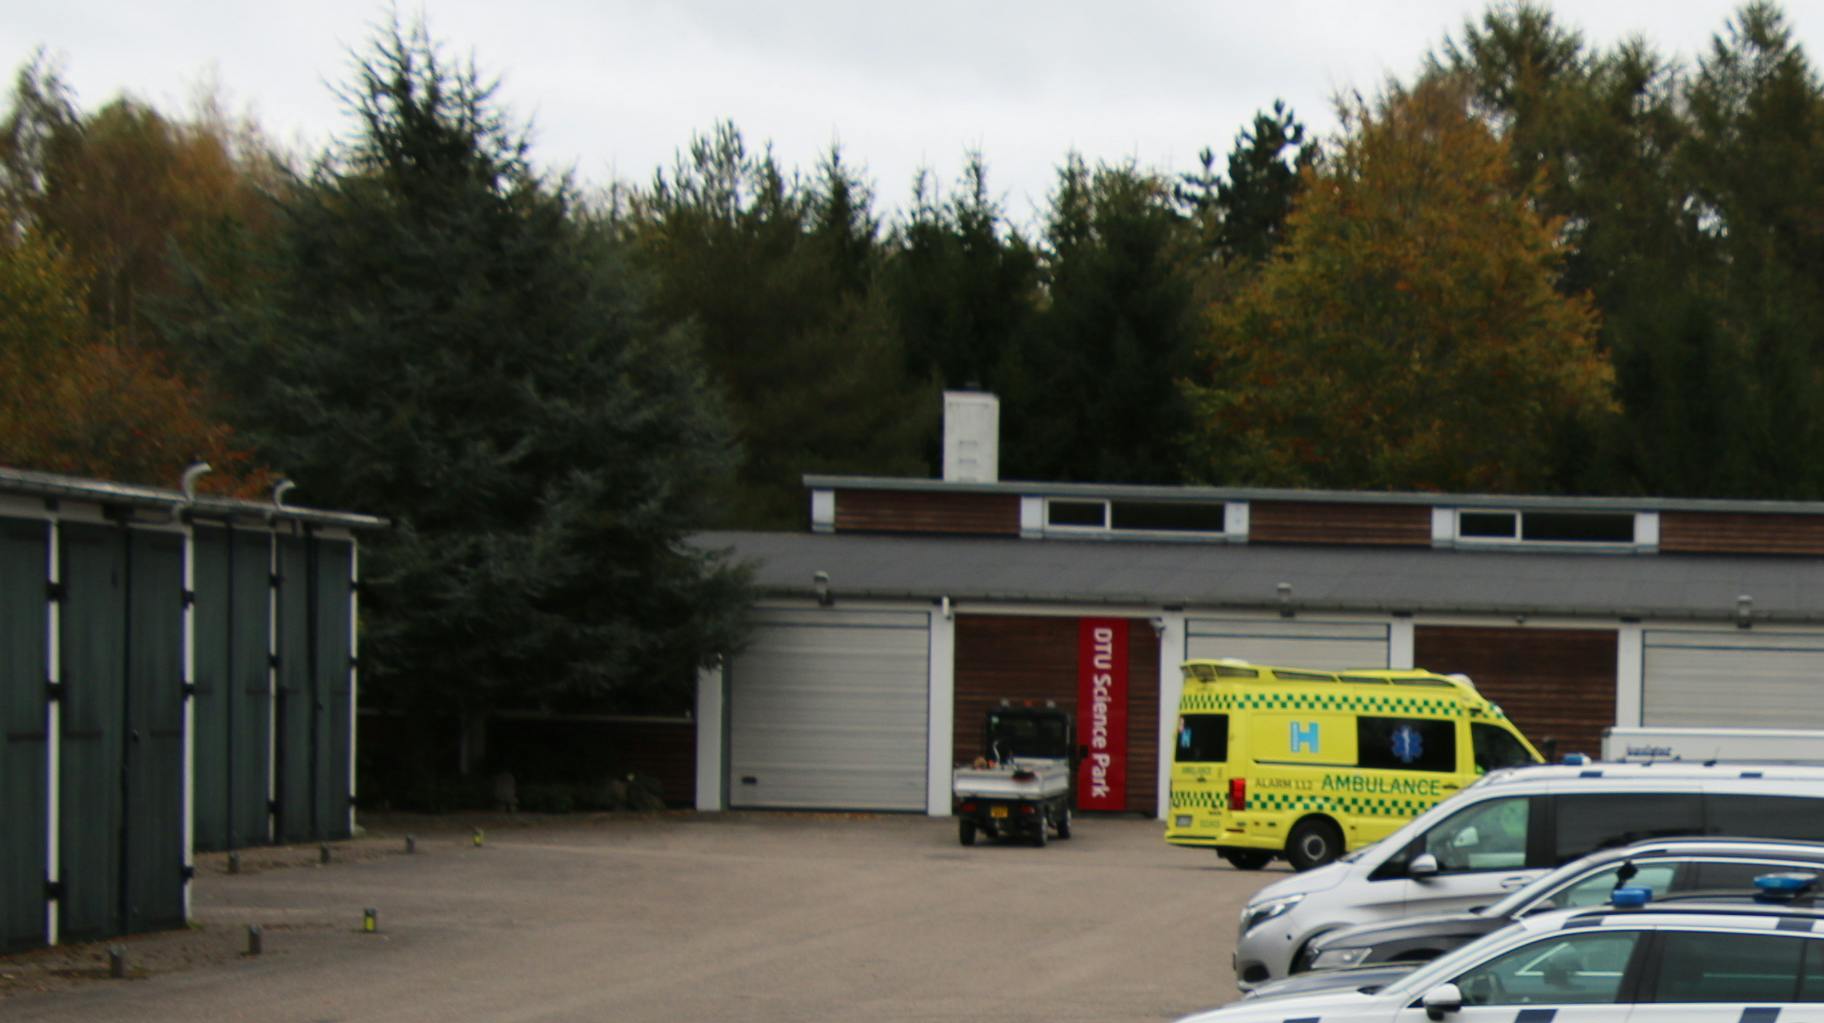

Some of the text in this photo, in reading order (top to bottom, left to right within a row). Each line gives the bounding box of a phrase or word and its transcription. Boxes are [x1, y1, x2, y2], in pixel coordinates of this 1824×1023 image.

[1091, 627, 1112, 798] DTU Science Park
[1290, 721, 1319, 753] H
[1321, 774, 1441, 796] AMBULANCE
